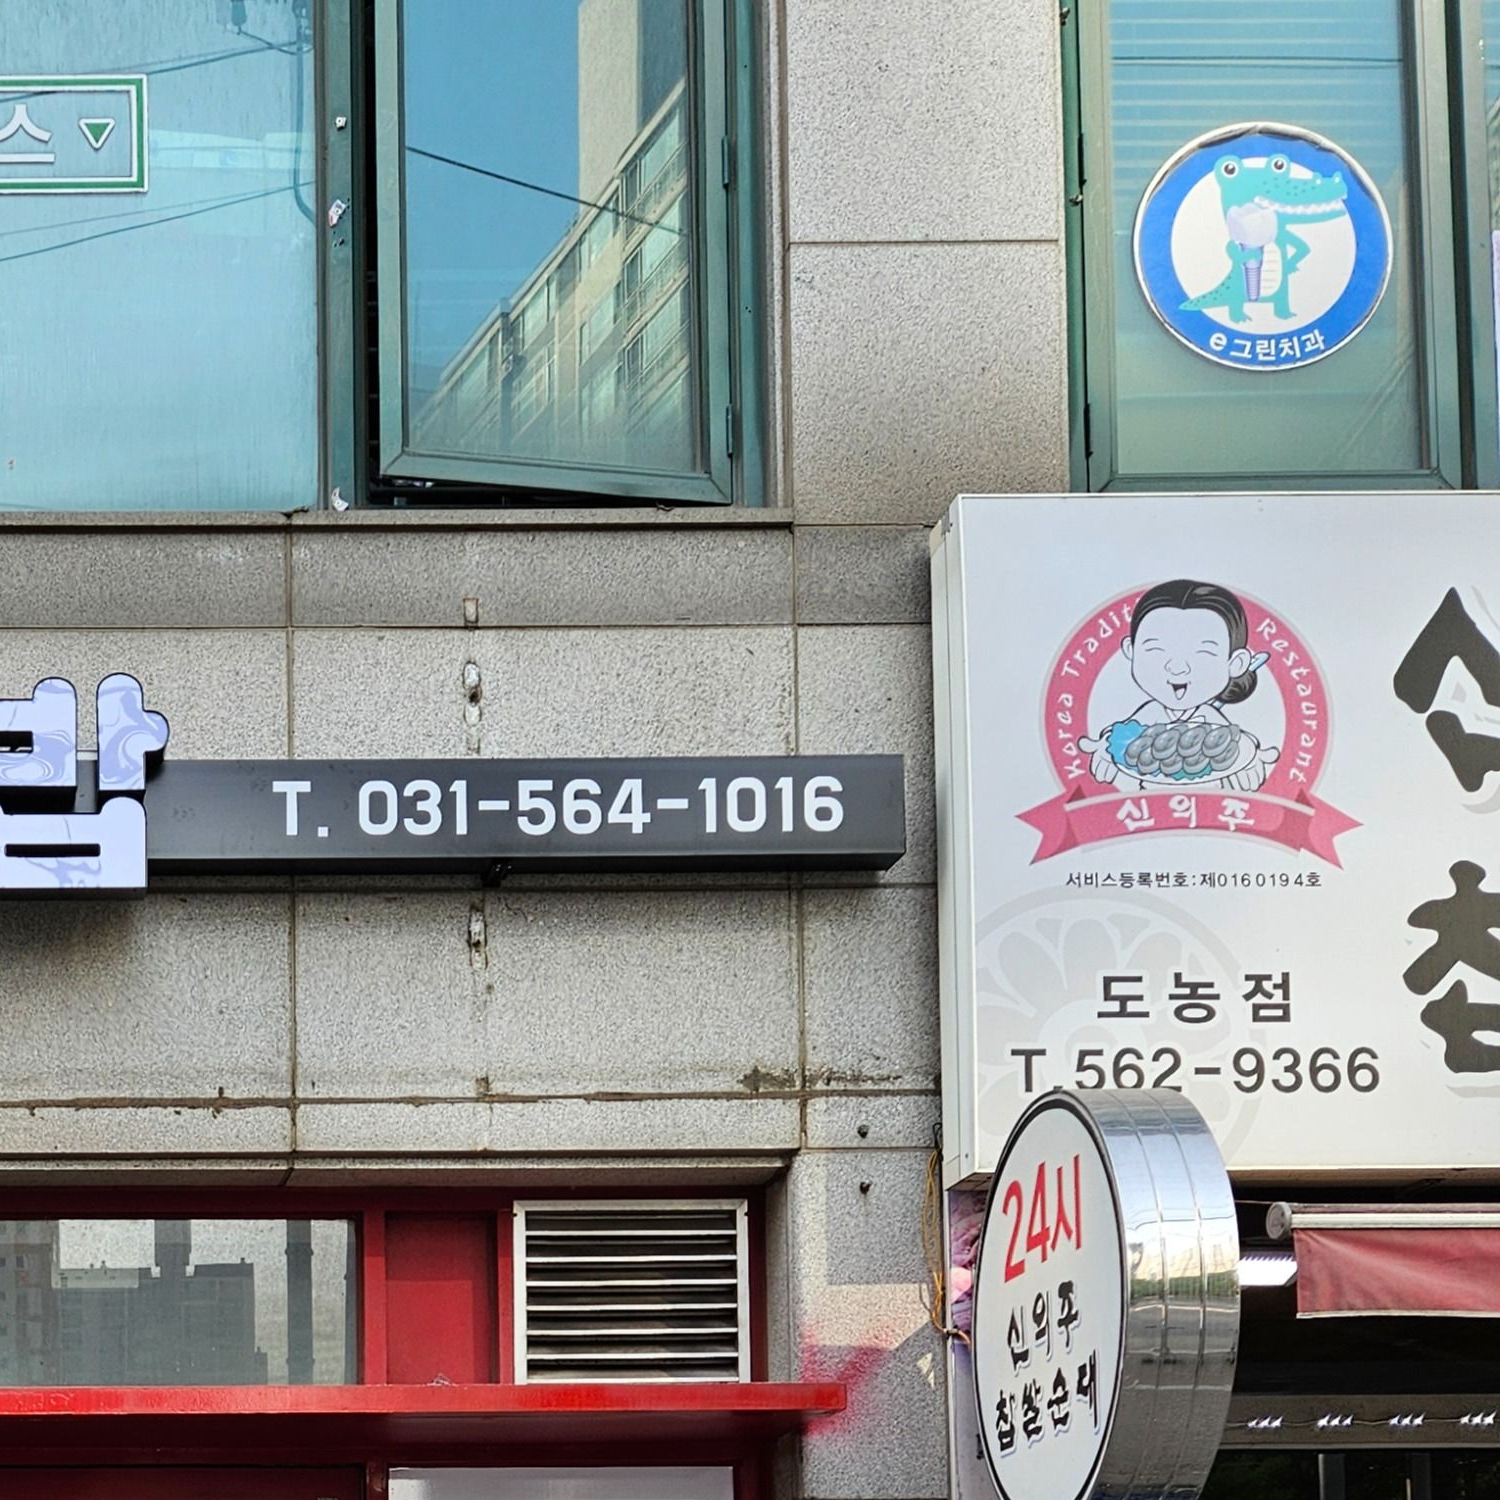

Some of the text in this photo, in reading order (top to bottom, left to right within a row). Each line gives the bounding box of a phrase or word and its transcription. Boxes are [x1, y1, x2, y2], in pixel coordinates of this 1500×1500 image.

[1057, 597, 1140, 779] Korea Tradit
[1256, 618, 1318, 783] Restaurant
[273, 776, 844, 838] T. 031-564-1016
[1002, 1154, 1082, 1283] 24시
[1007, 1280, 1080, 1372] 신의주
[996, 1349, 1098, 1451] 찹쌀순대
